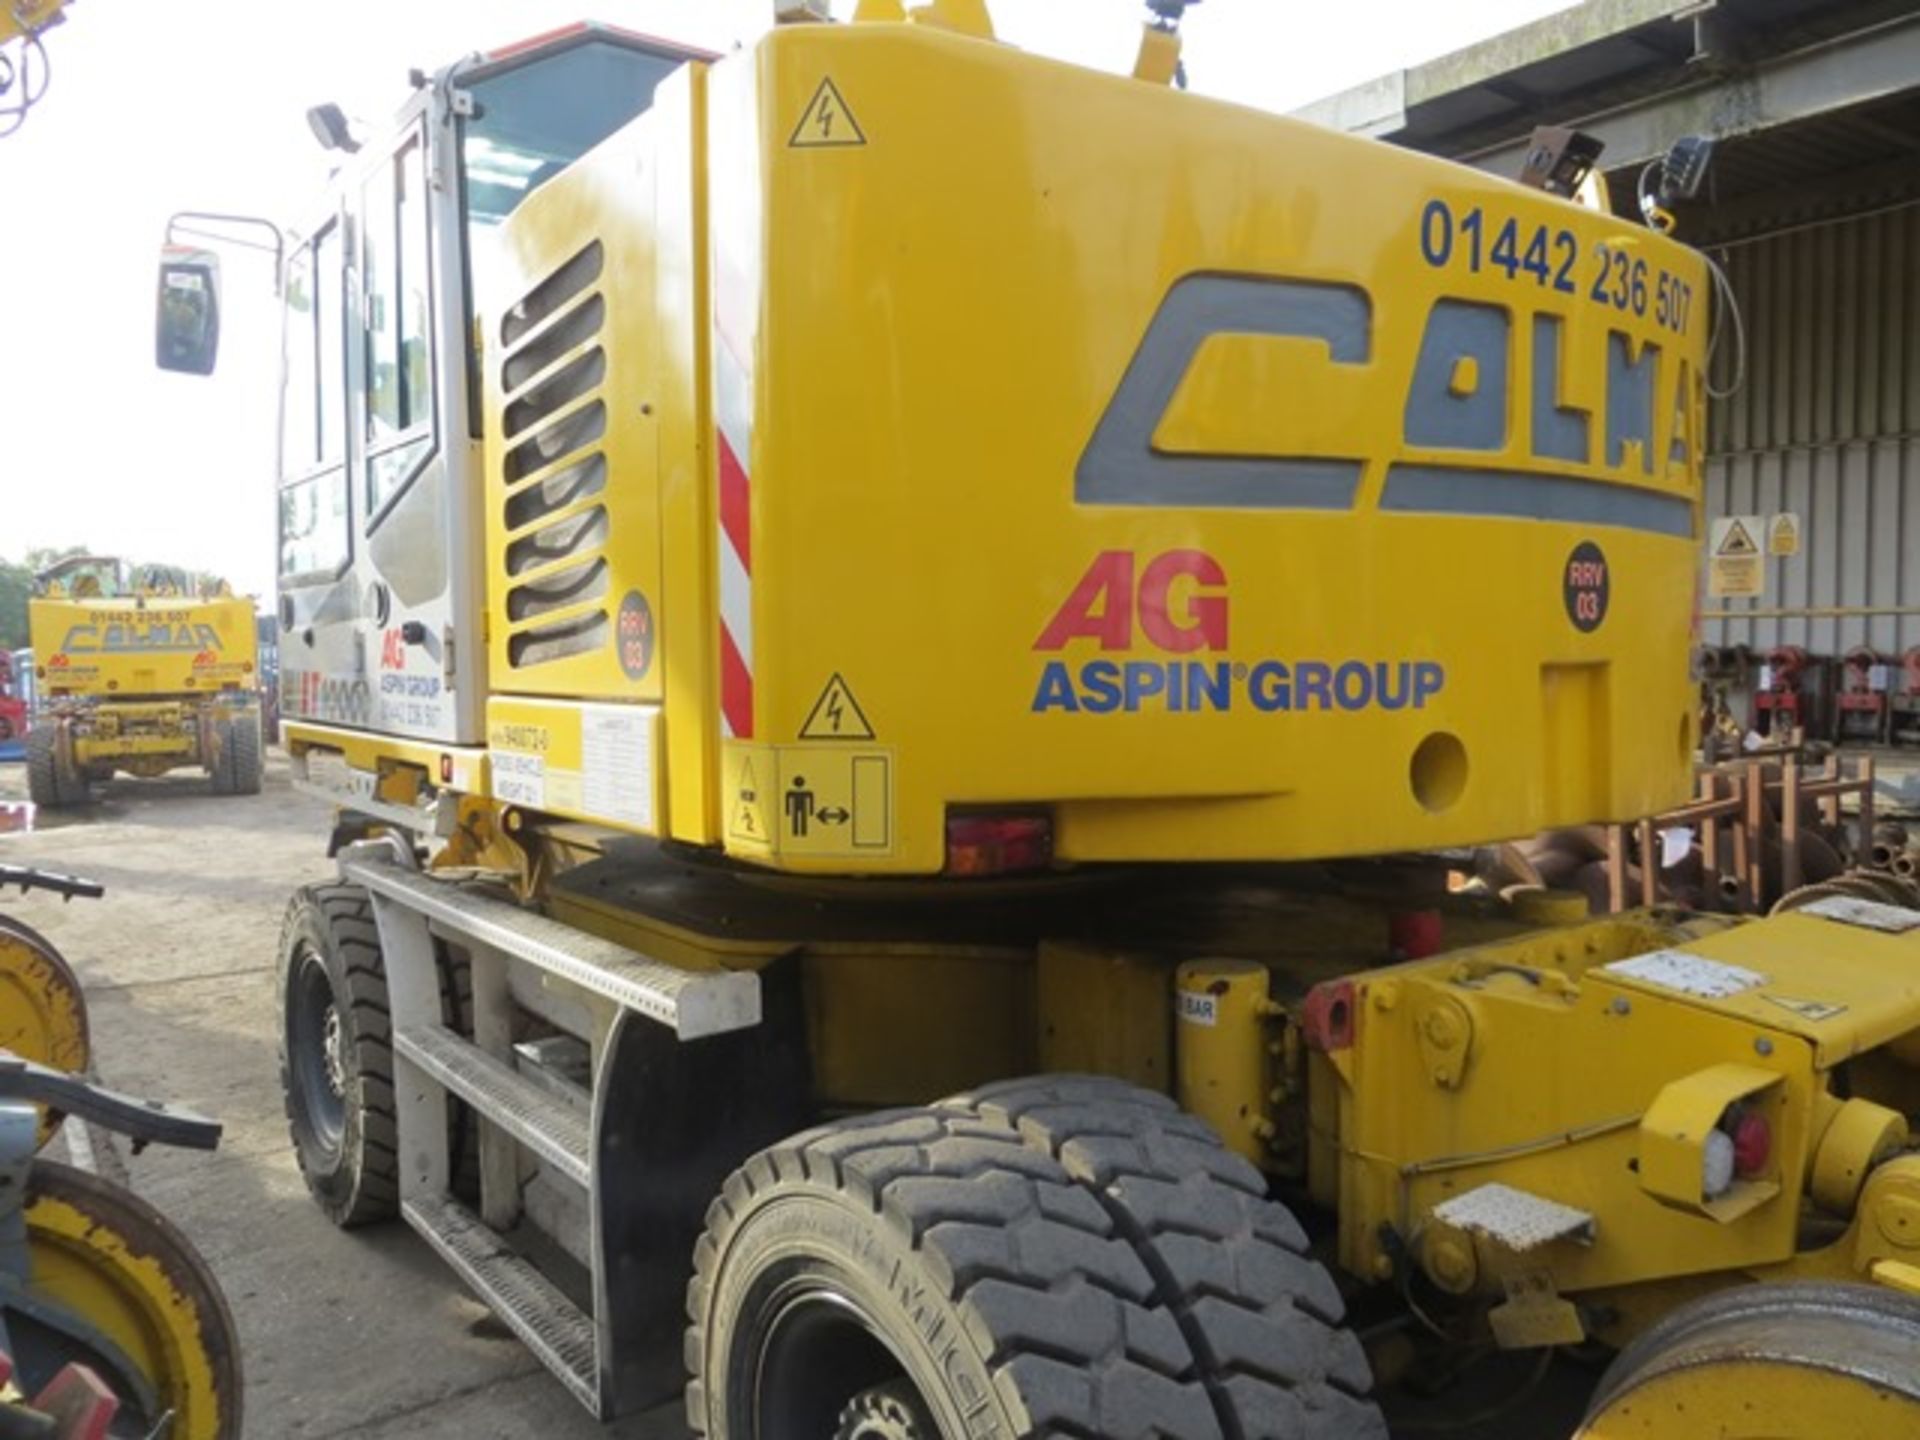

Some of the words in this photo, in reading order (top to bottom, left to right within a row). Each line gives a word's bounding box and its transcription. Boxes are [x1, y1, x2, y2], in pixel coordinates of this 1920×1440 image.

[1420, 198, 1577, 294] 01442
[1590, 244, 1649, 317] 236
[1655, 270, 1691, 337] 507
[1074, 270, 1704, 538] COLMA
[1570, 561, 1605, 587] RRV
[1031, 549, 1228, 653] AG
[1576, 592, 1597, 620] 03
[61, 623, 223, 654] COLMAR
[1247, 660, 1444, 711] GROUP
